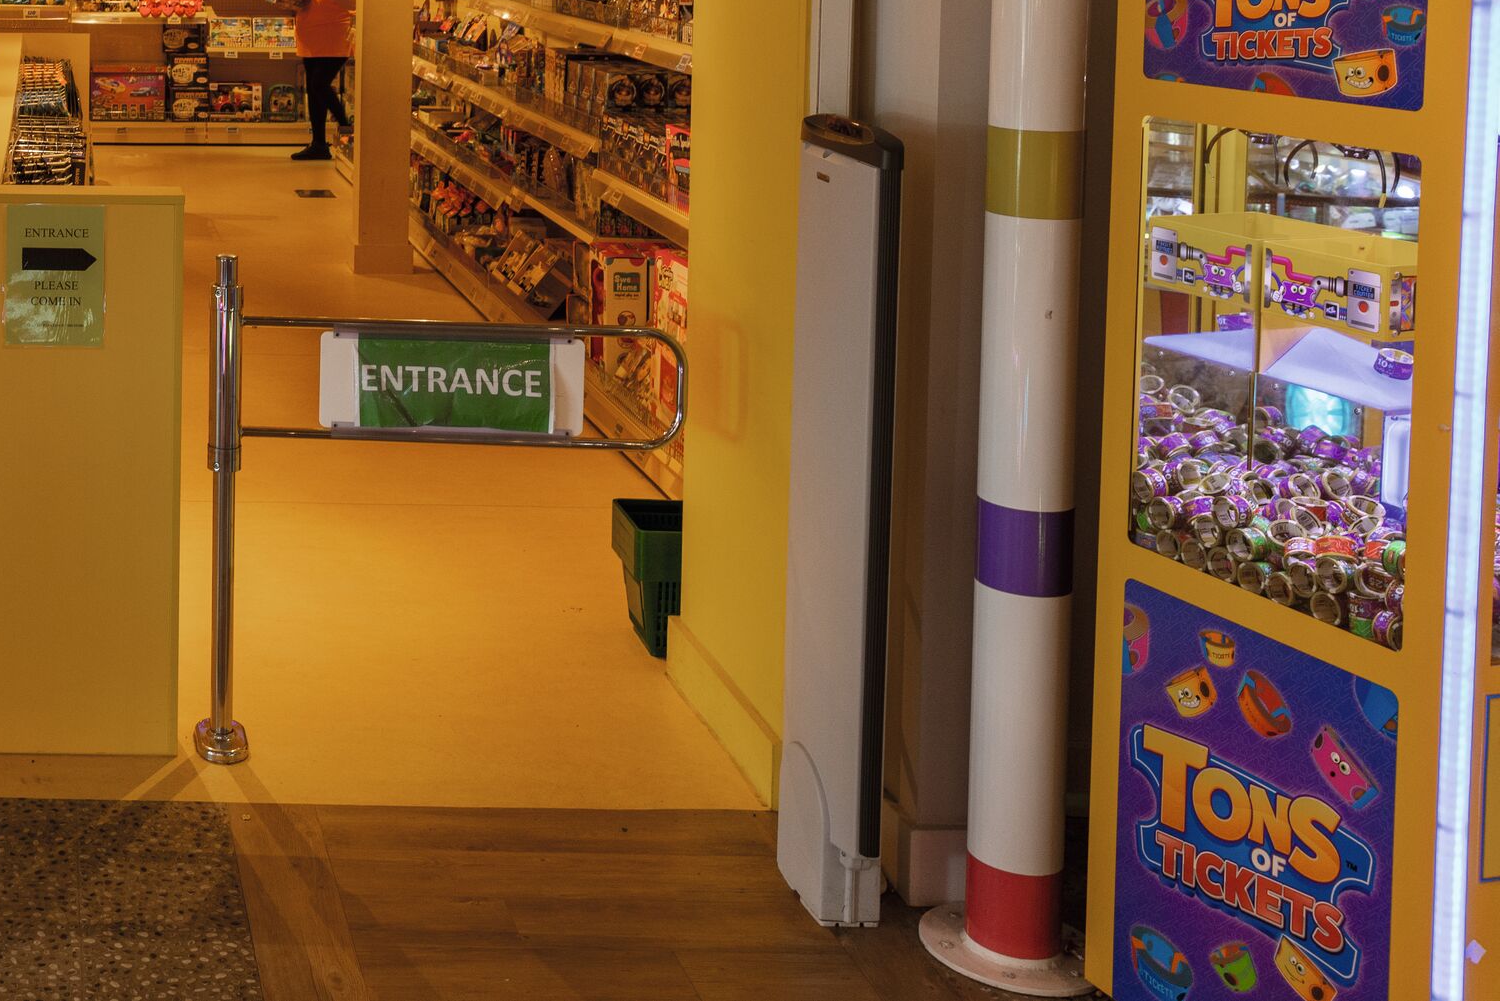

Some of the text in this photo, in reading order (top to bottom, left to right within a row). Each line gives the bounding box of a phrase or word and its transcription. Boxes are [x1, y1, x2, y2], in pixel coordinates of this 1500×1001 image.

[1274, 11, 1297, 28] OF
[1211, 28, 1333, 61] TICKETS
[25, 228, 89, 238] ENTRANCE
[34, 281, 78, 290] PLEASE
[30, 296, 81, 306] COME IN
[361, 364, 542, 397] ENTRANCE
[1143, 723, 1342, 884] TONS
[1251, 848, 1287, 873] OF
[1155, 830, 1346, 955] TICKETS
